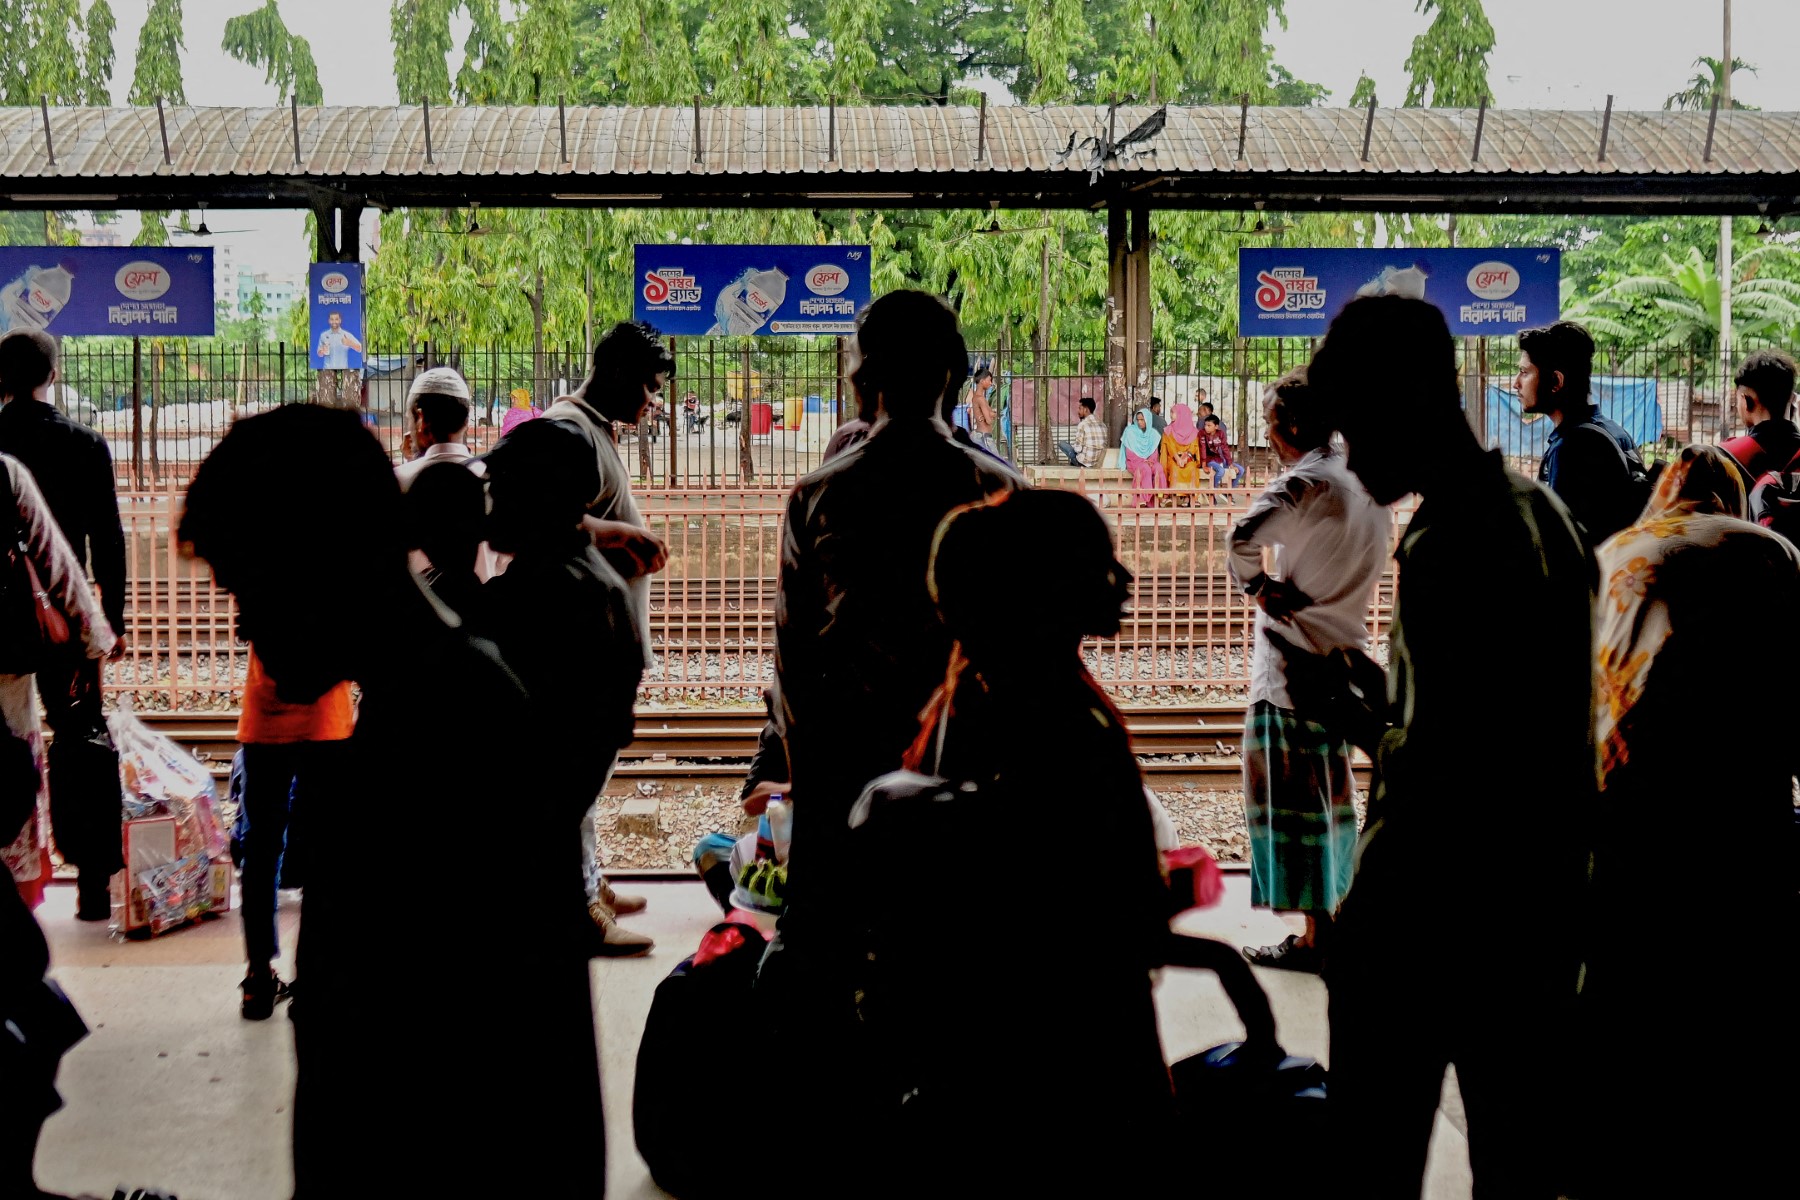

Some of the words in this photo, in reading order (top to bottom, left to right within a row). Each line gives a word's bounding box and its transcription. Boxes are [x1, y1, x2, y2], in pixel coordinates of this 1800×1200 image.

[659, 270, 682, 278] দেশের
[813, 271, 841, 287] ফ্রেশ
[1274, 270, 1301, 279] দেশের
[1475, 271, 1510, 289] ফ্রেশ
[645, 273, 669, 303] ১
[668, 278, 693, 289] নম্বর
[1258, 273, 1286, 309] ১
[1285, 279, 1315, 292] নম্বর
[669, 289, 700, 302] ব্র্যান্ড
[749, 291, 768, 309] Fresh
[1286, 293, 1323, 308] ব্র্যান্ড
[108, 305, 150, 325] নিরাপদ
[153, 305, 177, 324] পানি
[800, 300, 833, 316] নিরাপদ
[834, 300, 854, 315] পানি
[1460, 305, 1500, 324] নিরাপদ
[1503, 305, 1526, 322] পানি
